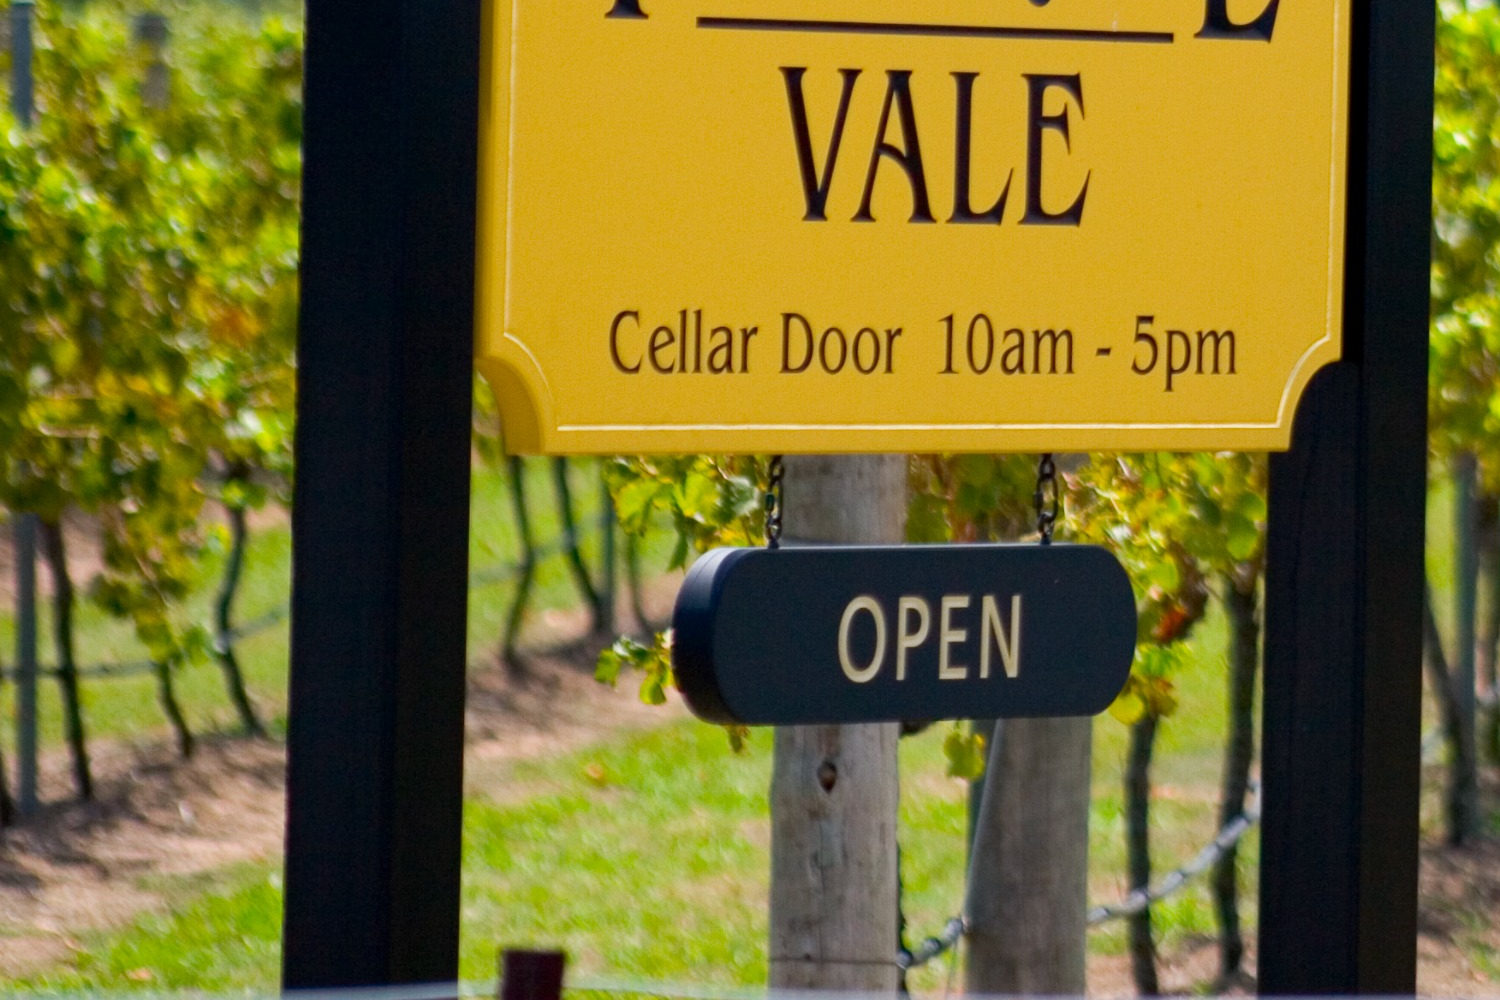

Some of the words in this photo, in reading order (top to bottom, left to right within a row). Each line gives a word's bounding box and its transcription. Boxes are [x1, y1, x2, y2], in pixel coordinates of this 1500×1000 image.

[779, 66, 1092, 227] VALE
[609, 309, 759, 375] Cellar
[780, 311, 904, 375] Door
[940, 313, 1075, 375] 10am
[1095, 346, 1112, 357] -
[1131, 315, 1237, 393] 5pm
[837, 594, 1022, 684] OPEN
